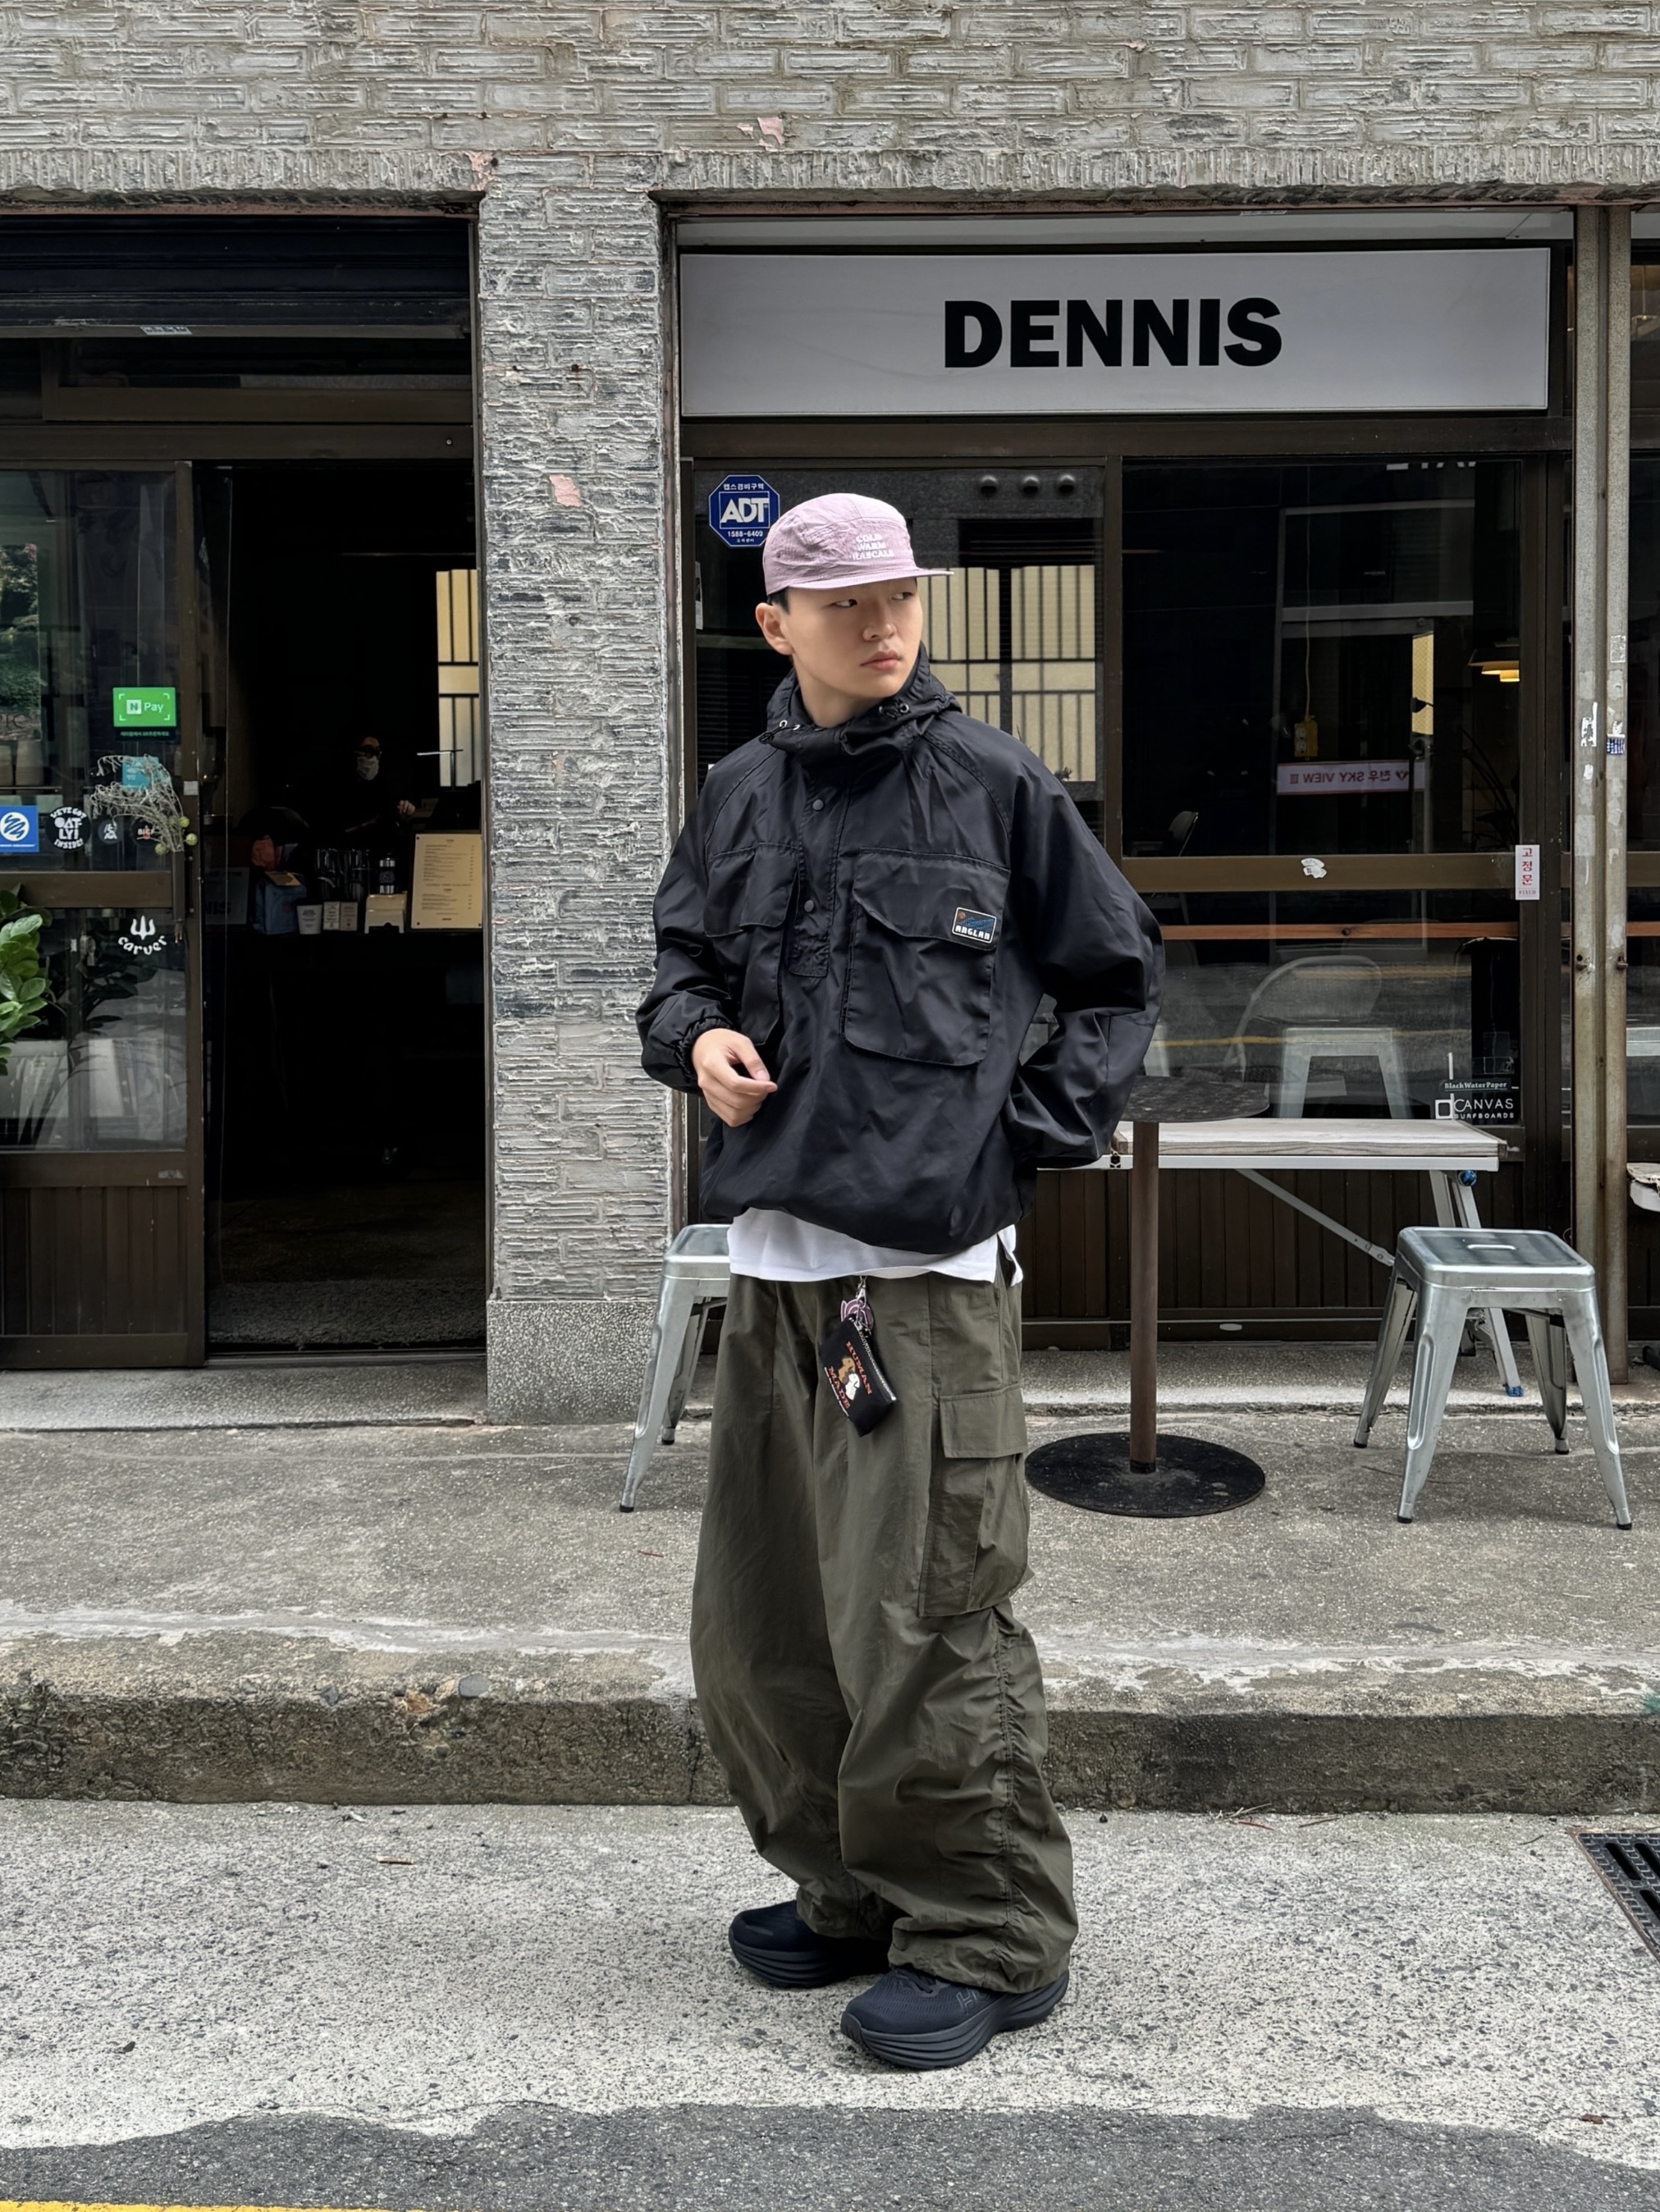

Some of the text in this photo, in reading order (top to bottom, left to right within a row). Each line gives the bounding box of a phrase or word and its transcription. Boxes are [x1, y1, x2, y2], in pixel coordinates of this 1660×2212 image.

[944, 297, 1282, 368] DENNIS
[720, 497, 769, 523] ADT
[857, 542, 886, 551] WARM
[144, 702, 163, 713] Pay
[1521, 848, 1533, 885] 고정문
[117, 935, 167, 955] carver
[1453, 1098, 1514, 1113] CANVAS
